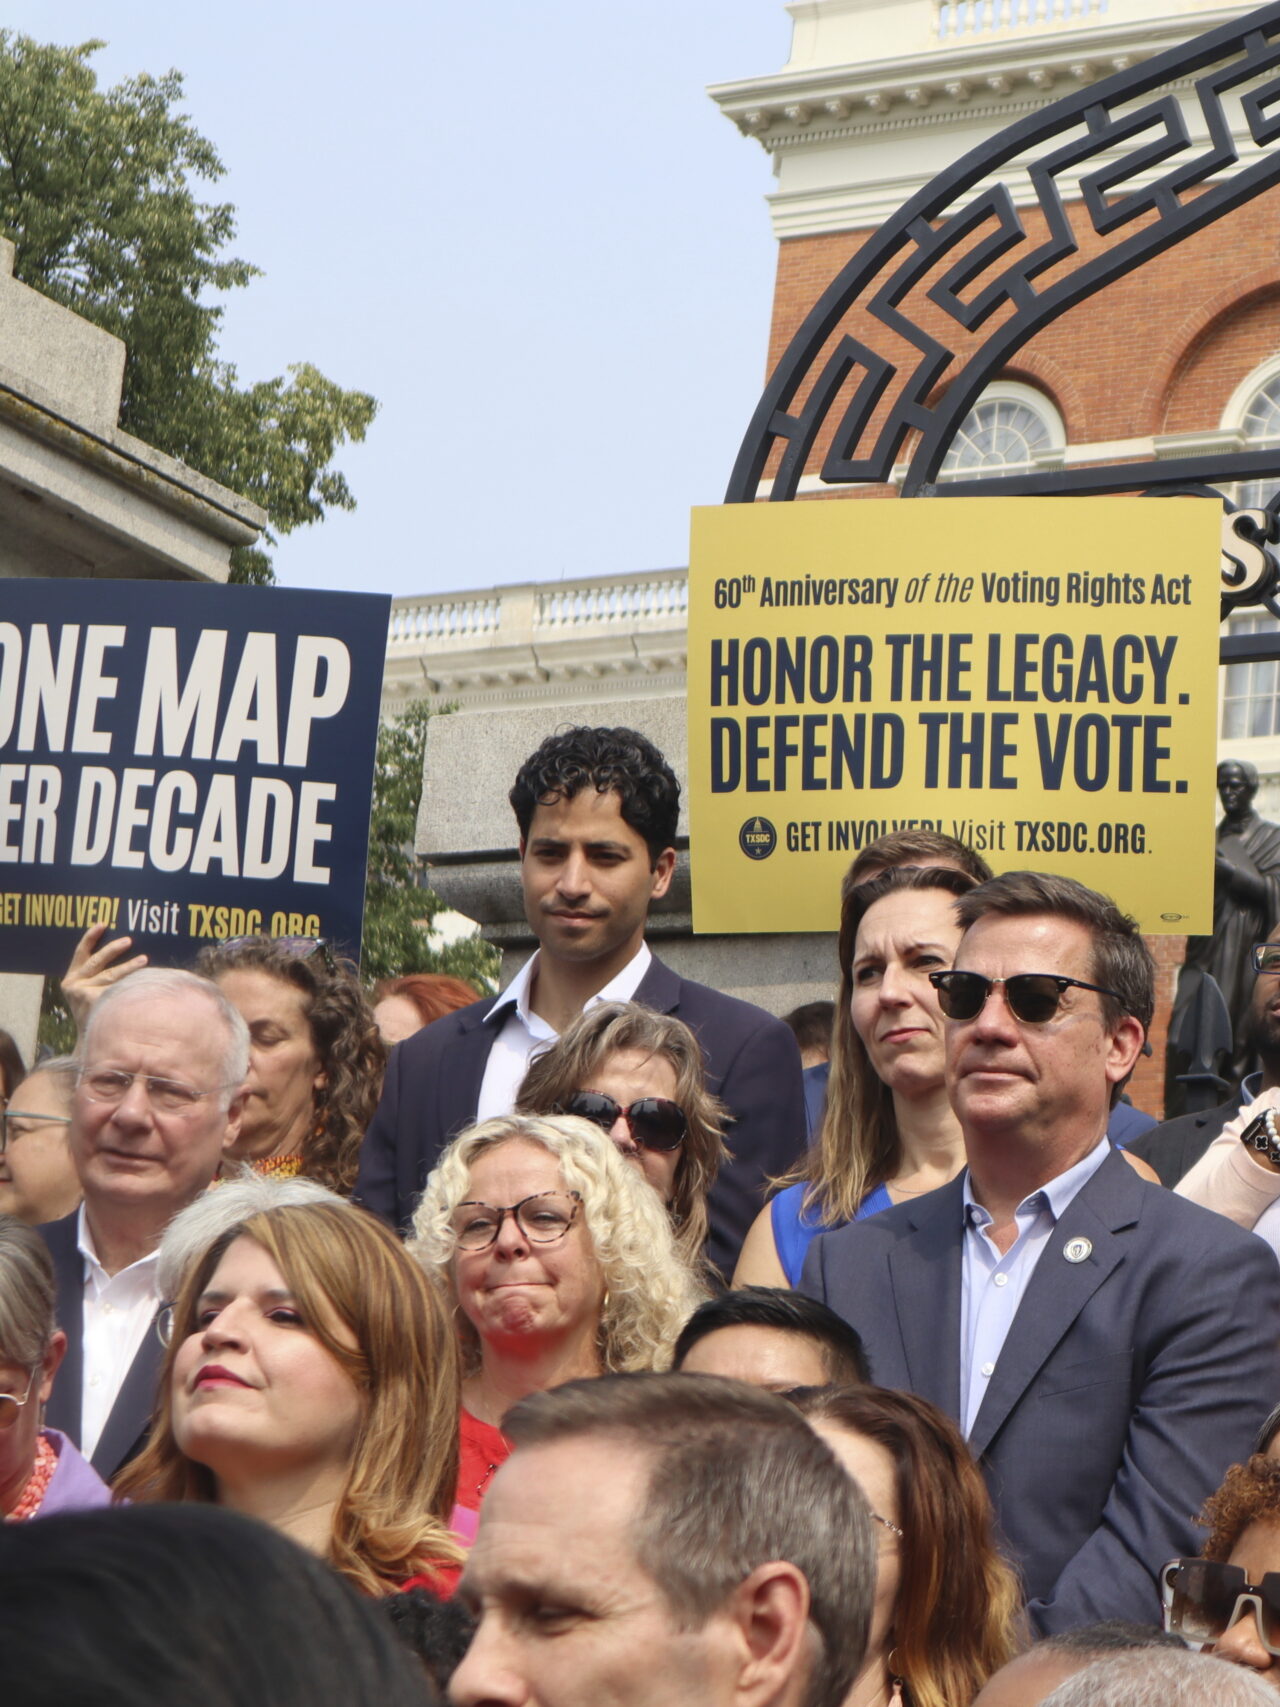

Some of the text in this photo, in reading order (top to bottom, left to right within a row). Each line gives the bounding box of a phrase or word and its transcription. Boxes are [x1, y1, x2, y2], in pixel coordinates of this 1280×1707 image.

[714, 571, 1192, 609] 60th Anniversary of the Voting Rights Act
[133, 626, 351, 768] MAP
[710, 633, 1190, 707] HONOR THE LEGACY.
[710, 712, 1189, 794] DEFEND THE VOTE.
[0, 764, 337, 885] ER DECADE
[745, 833, 771, 843] TXSDC
[786, 821, 823, 852] GET
[953, 819, 1006, 851] Visit
[0, 893, 320, 939] ET INVOLVED! Visit TXSDCORG
